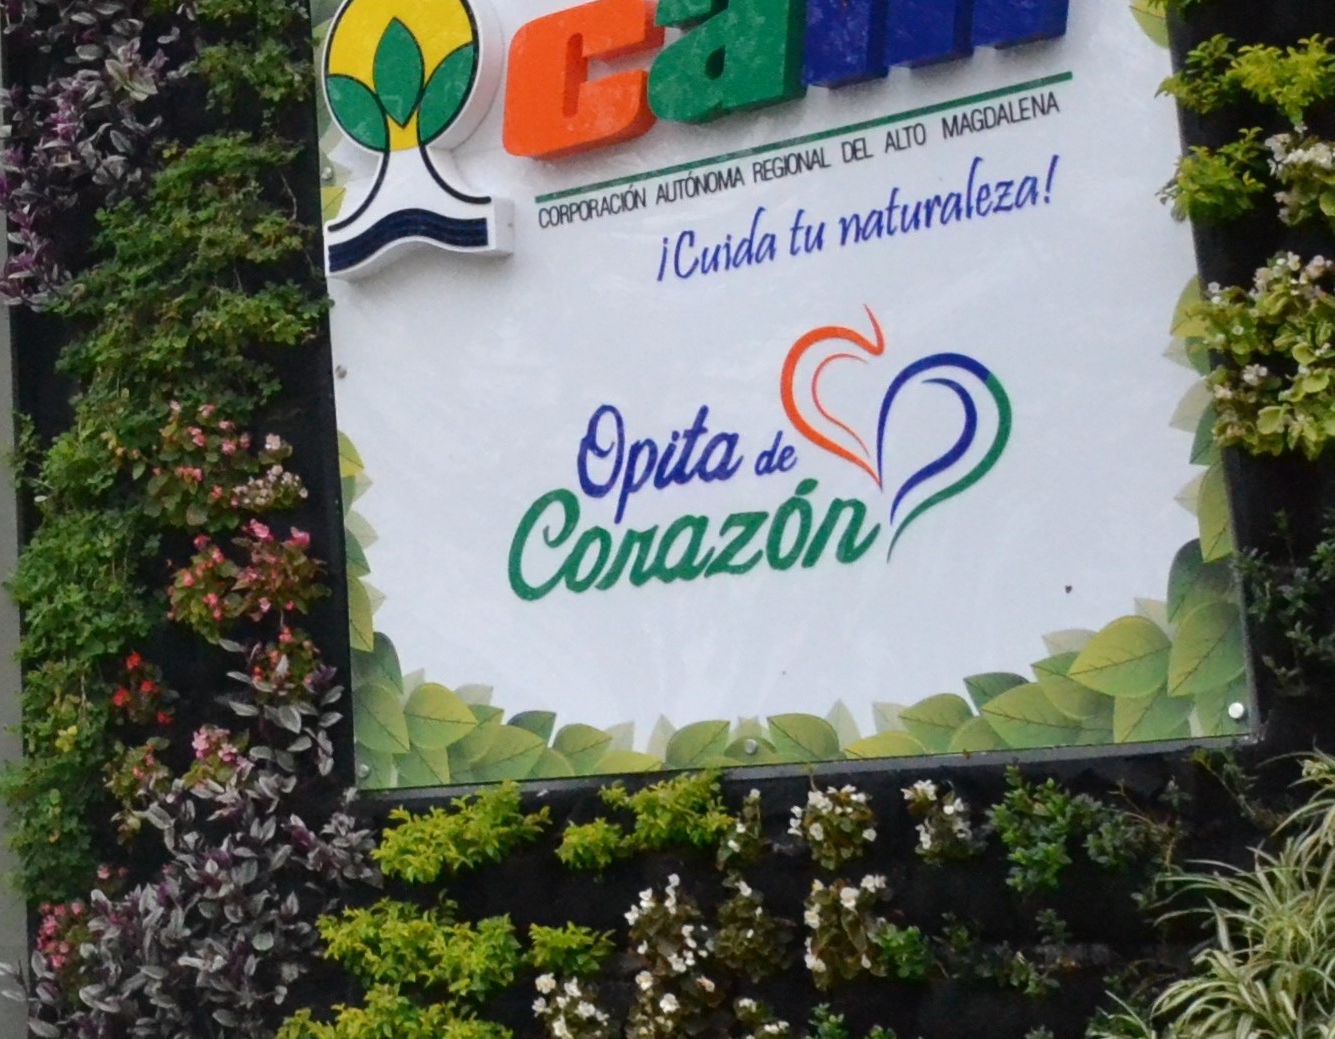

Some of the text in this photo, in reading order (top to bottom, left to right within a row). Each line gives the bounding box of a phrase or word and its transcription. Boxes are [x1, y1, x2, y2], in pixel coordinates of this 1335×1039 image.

[537, 90, 1060, 230] CORPORACIÓN AUTÓNOMA REGIONAL DEL ALTO MAGDALENA
[656, 154, 1060, 282] ¡Cuida tu naturaleza!
[576, 403, 799, 525] Opita de
[507, 477, 882, 602] Corazón
